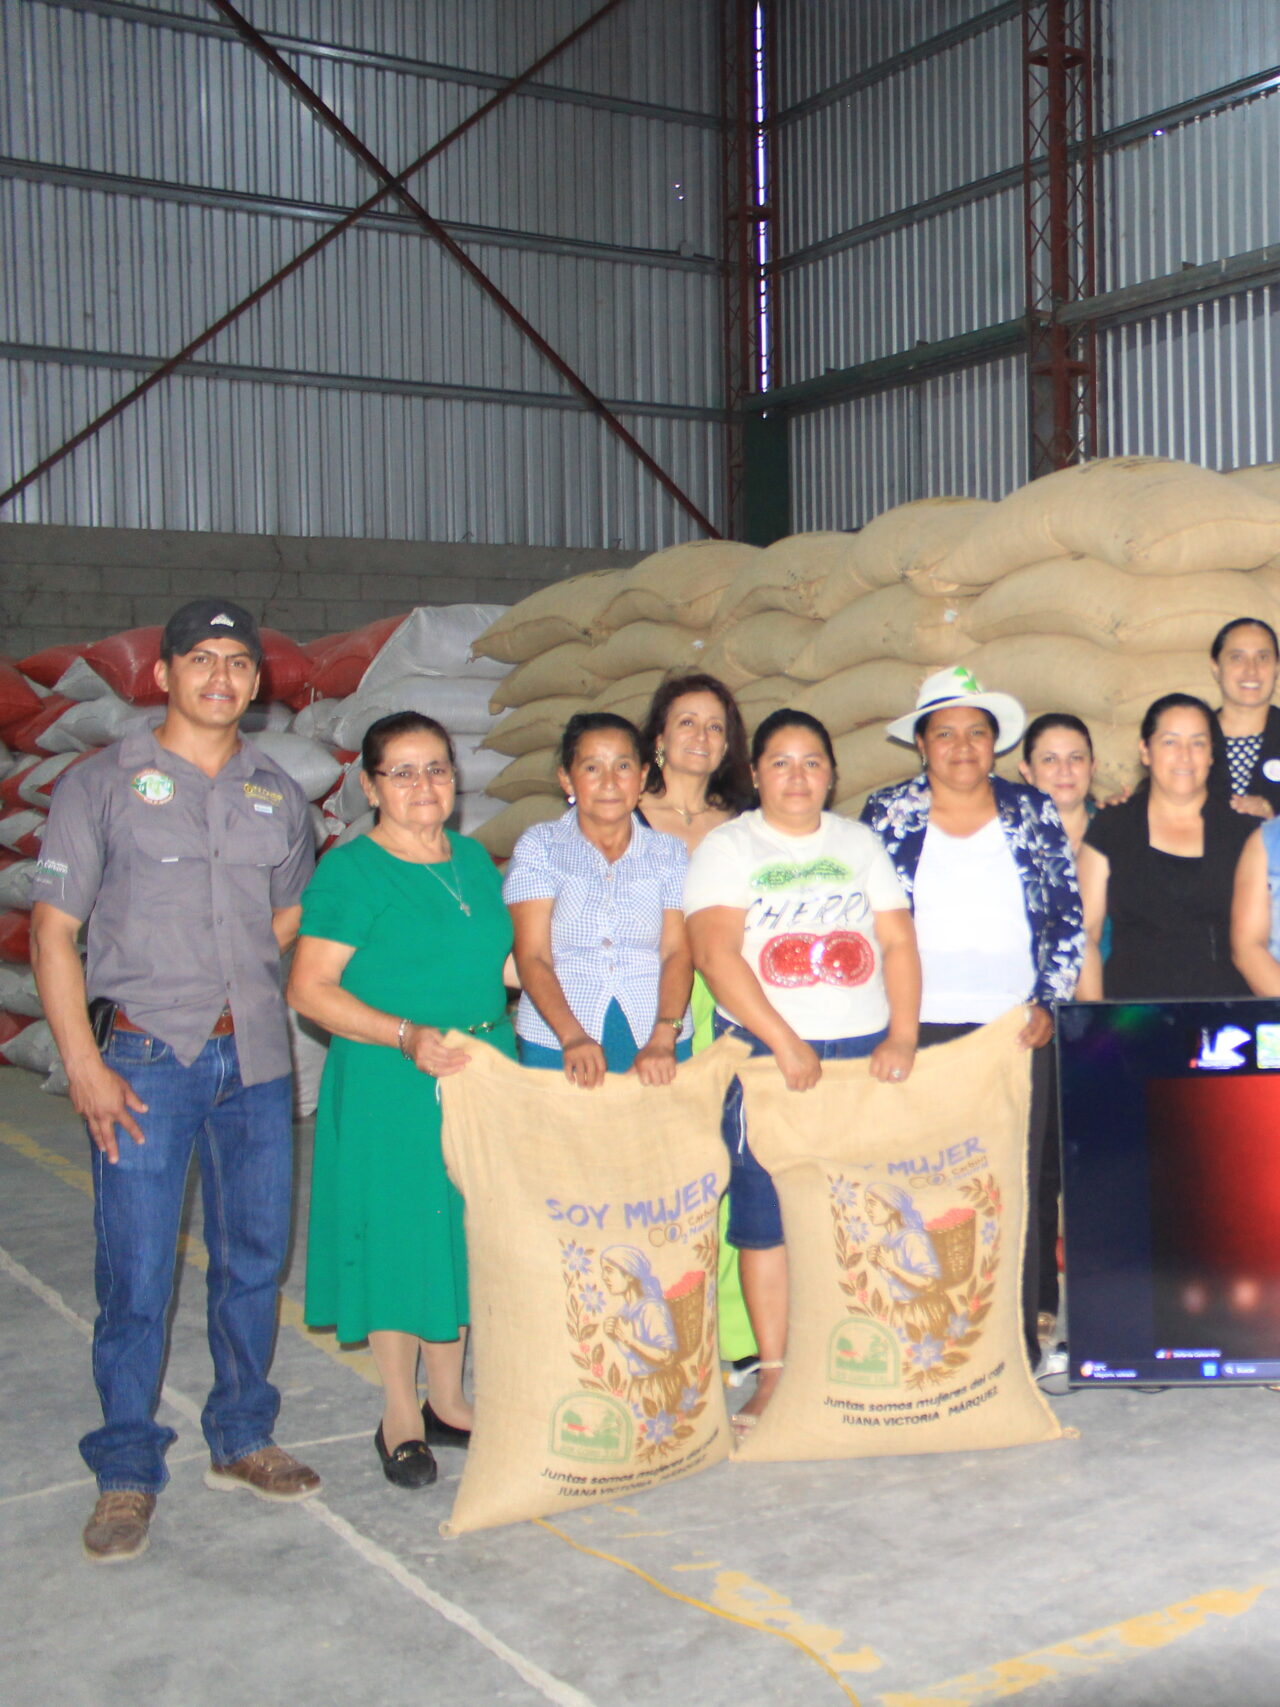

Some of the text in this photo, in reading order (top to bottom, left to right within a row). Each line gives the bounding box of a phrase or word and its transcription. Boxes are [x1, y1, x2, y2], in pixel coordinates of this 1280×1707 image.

[887, 1137, 986, 1177] MUJER
[546, 1172, 719, 1230] SOY MUJER
[823, 1396, 865, 1412] Juntas
[868, 1401, 913, 1412] somos
[915, 1386, 968, 1407] mujeres
[970, 1374, 986, 1390] del
[841, 1414, 880, 1426] JUANA
[883, 1411, 940, 1426] VICTORIA
[541, 1467, 587, 1485] Juntas
[590, 1472, 634, 1485] somos
[557, 1486, 598, 1497] JUANA
